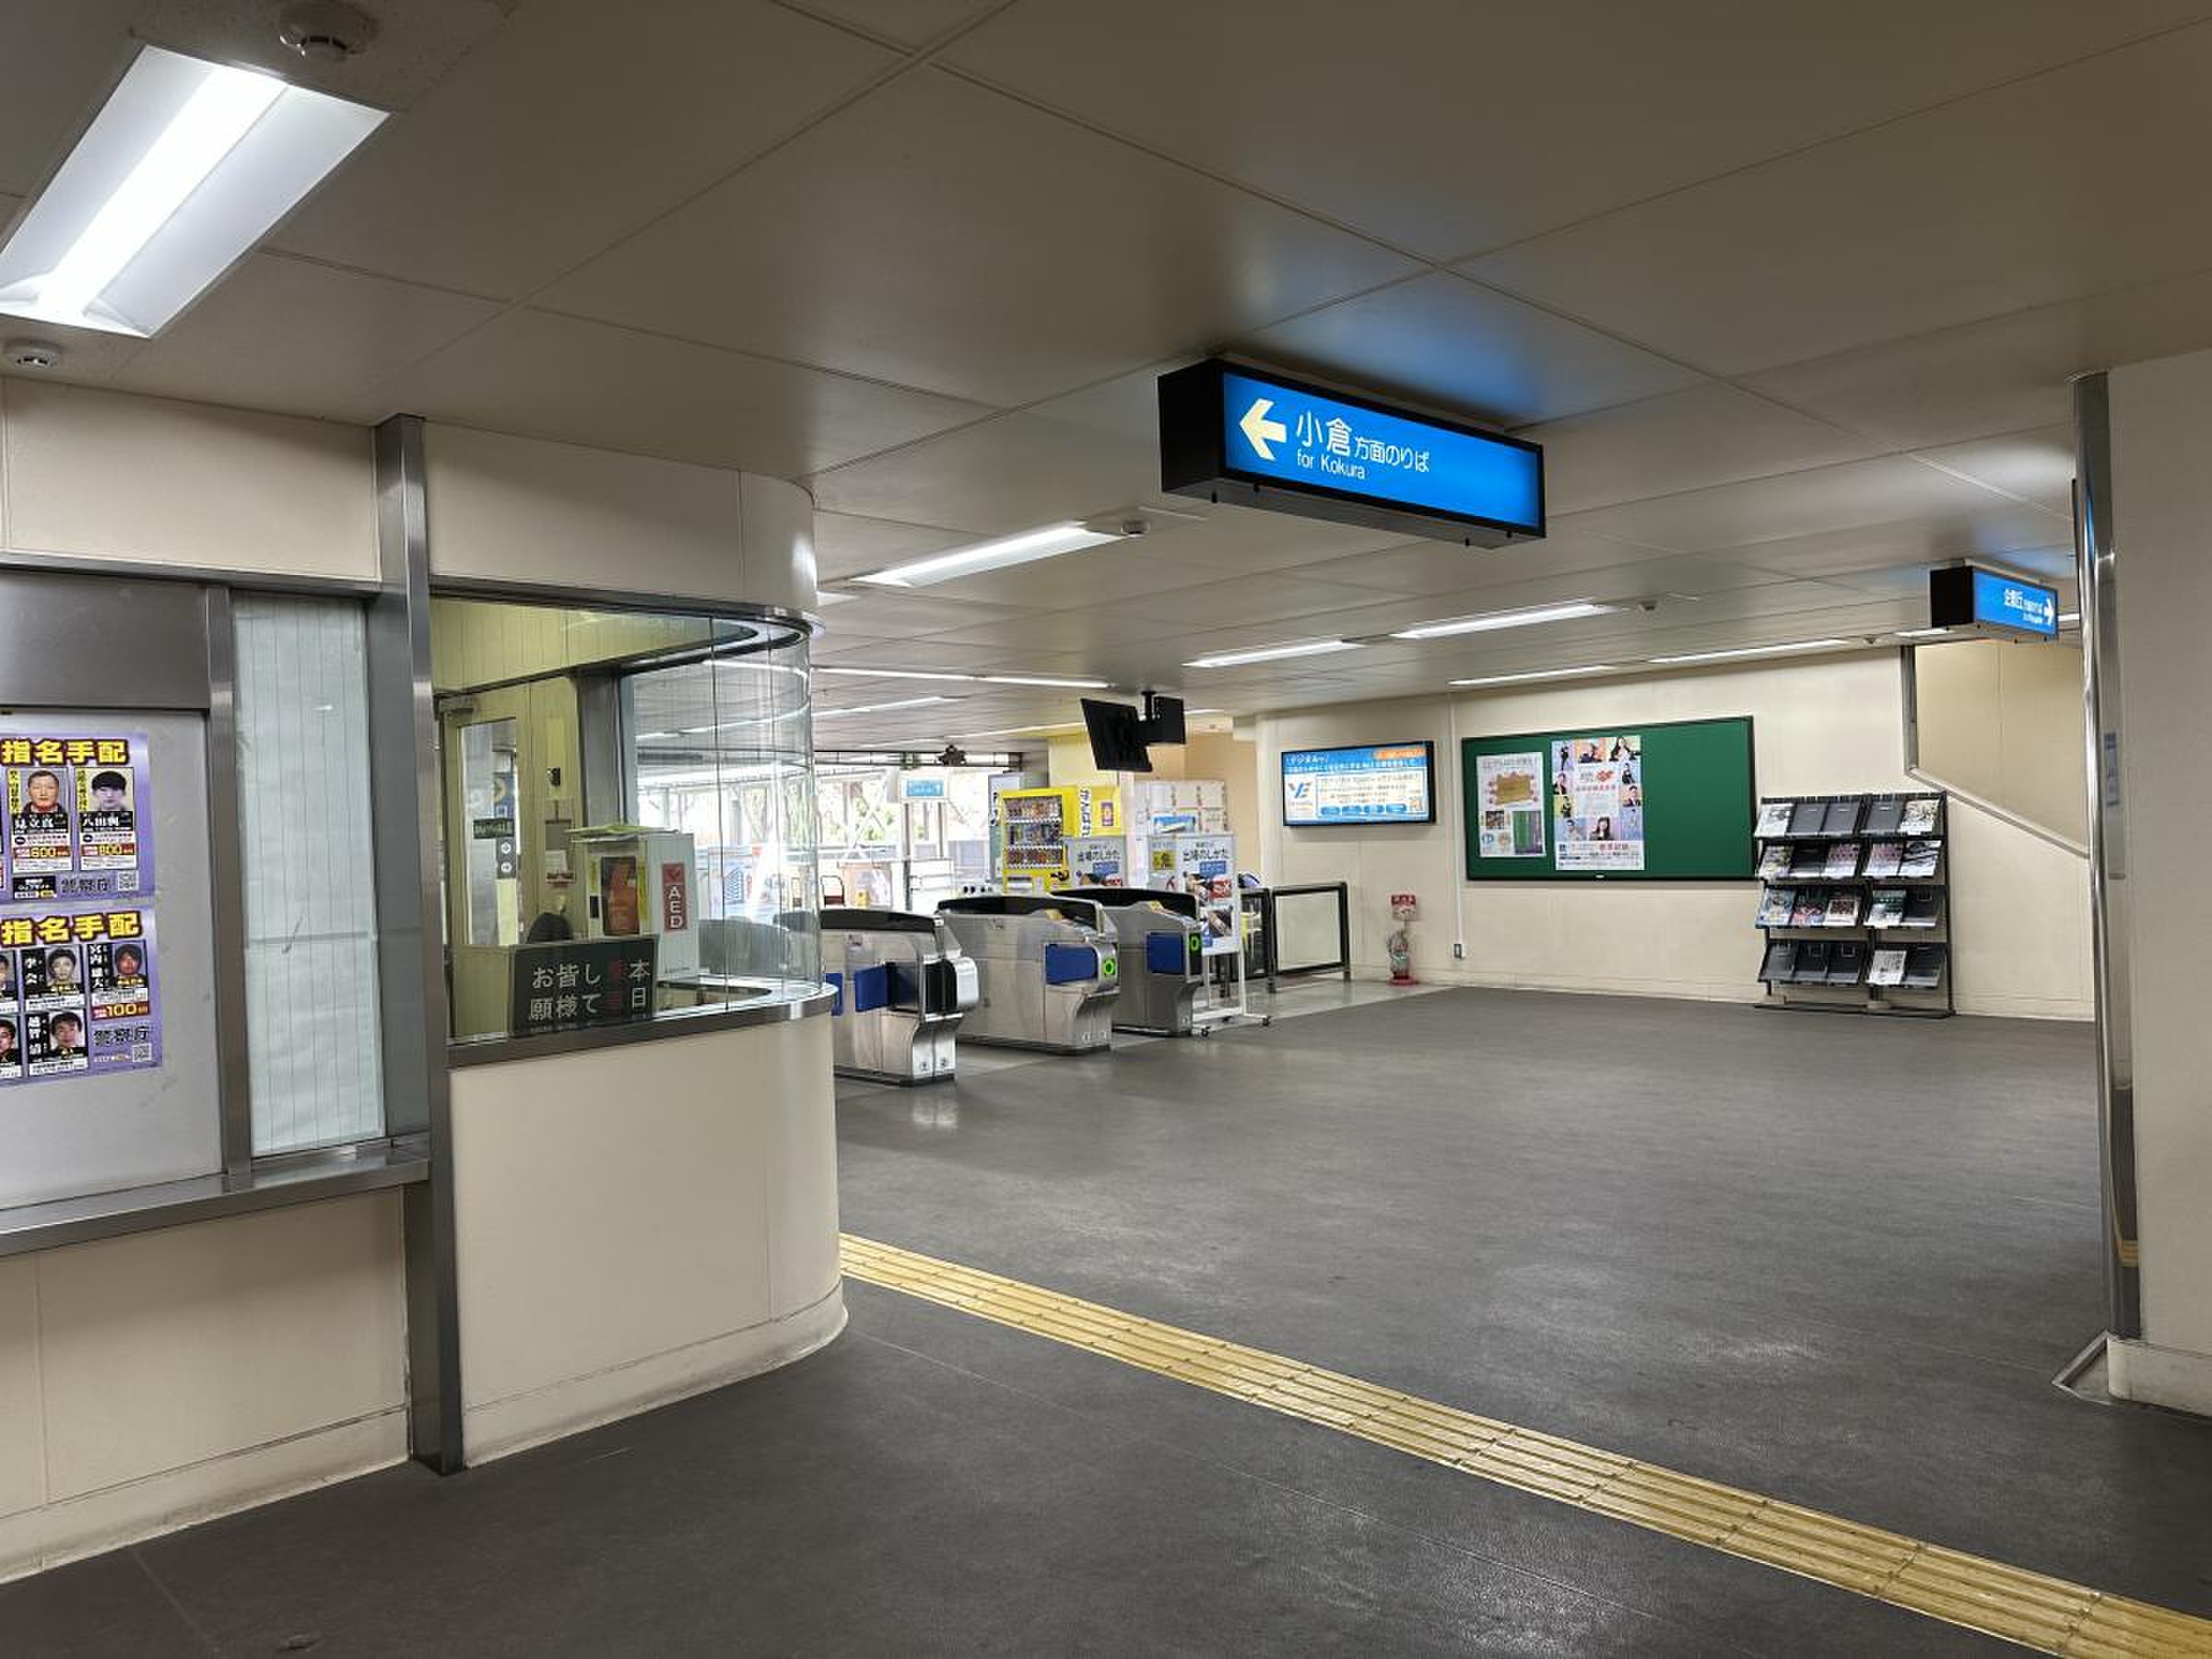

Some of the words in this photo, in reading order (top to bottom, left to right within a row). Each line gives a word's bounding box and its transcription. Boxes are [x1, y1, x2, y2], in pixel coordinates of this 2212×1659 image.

[1296, 410, 1430, 473] 小倉方面のりば
[1297, 448, 1313, 468] for
[1321, 453, 1365, 480] Kokura
[2, 740, 127, 764] 指名手配
[668, 885, 684, 929] AED
[2, 912, 139, 944] 指名手配
